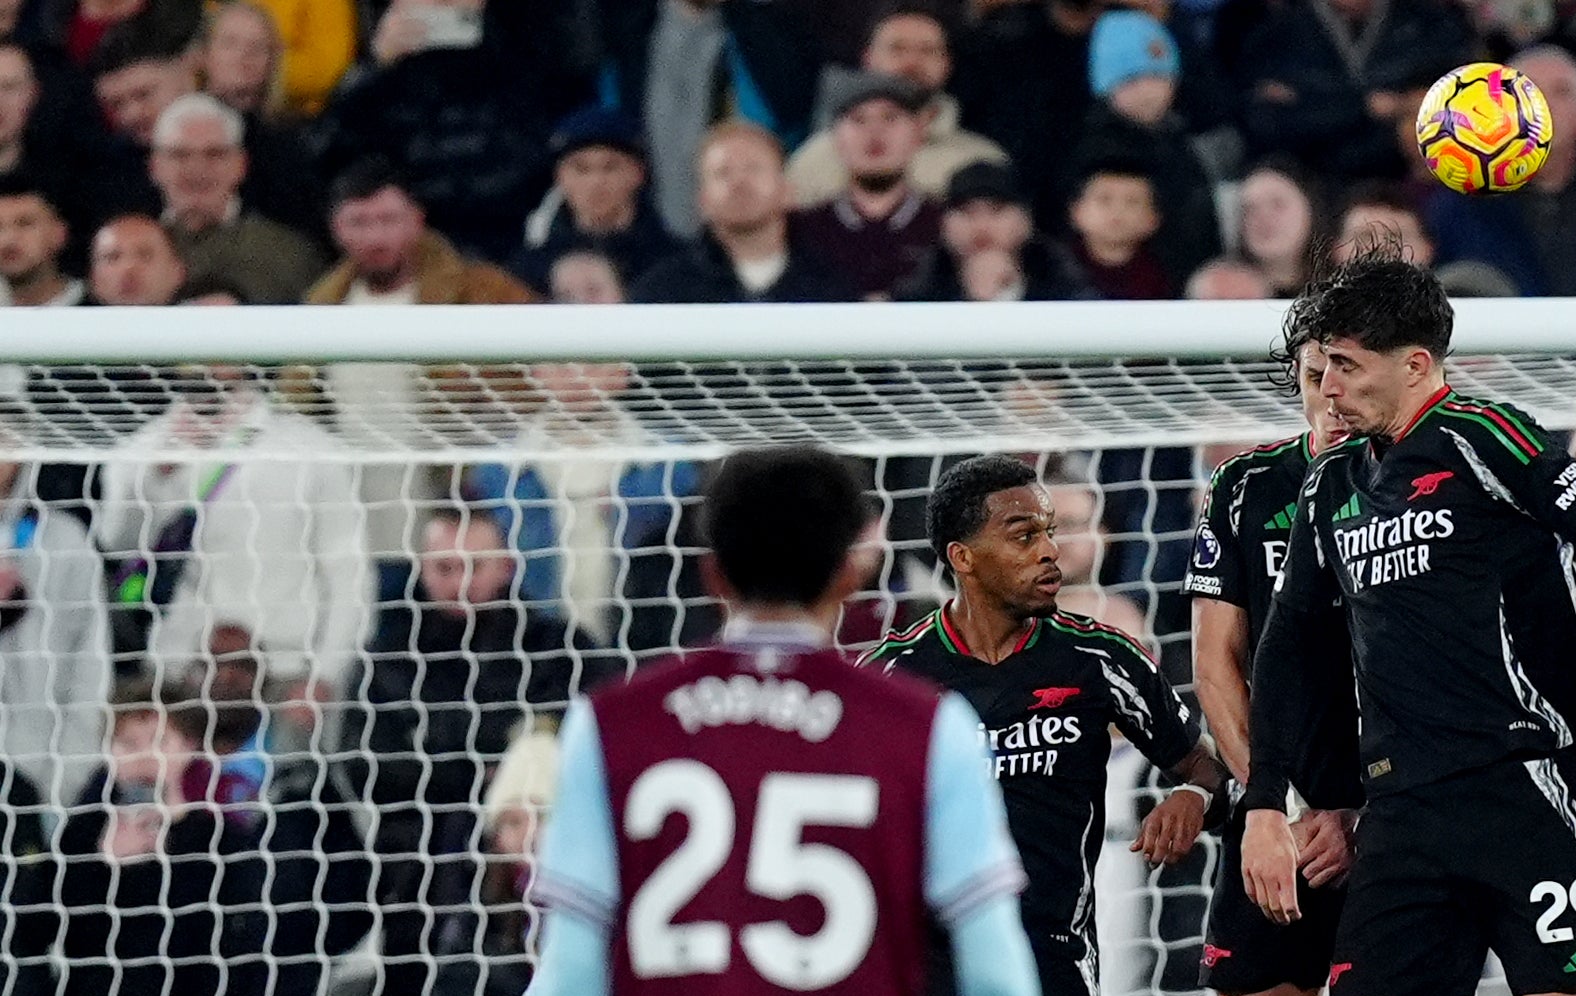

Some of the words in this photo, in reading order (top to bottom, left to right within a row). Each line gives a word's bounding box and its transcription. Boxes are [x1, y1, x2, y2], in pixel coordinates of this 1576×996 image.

[1333, 507, 1455, 565] Emirates
[1370, 544, 1432, 587] BETTER
[975, 714, 1082, 751] irates
[984, 750, 1059, 780] ETTER
[625, 758, 879, 991] 25
